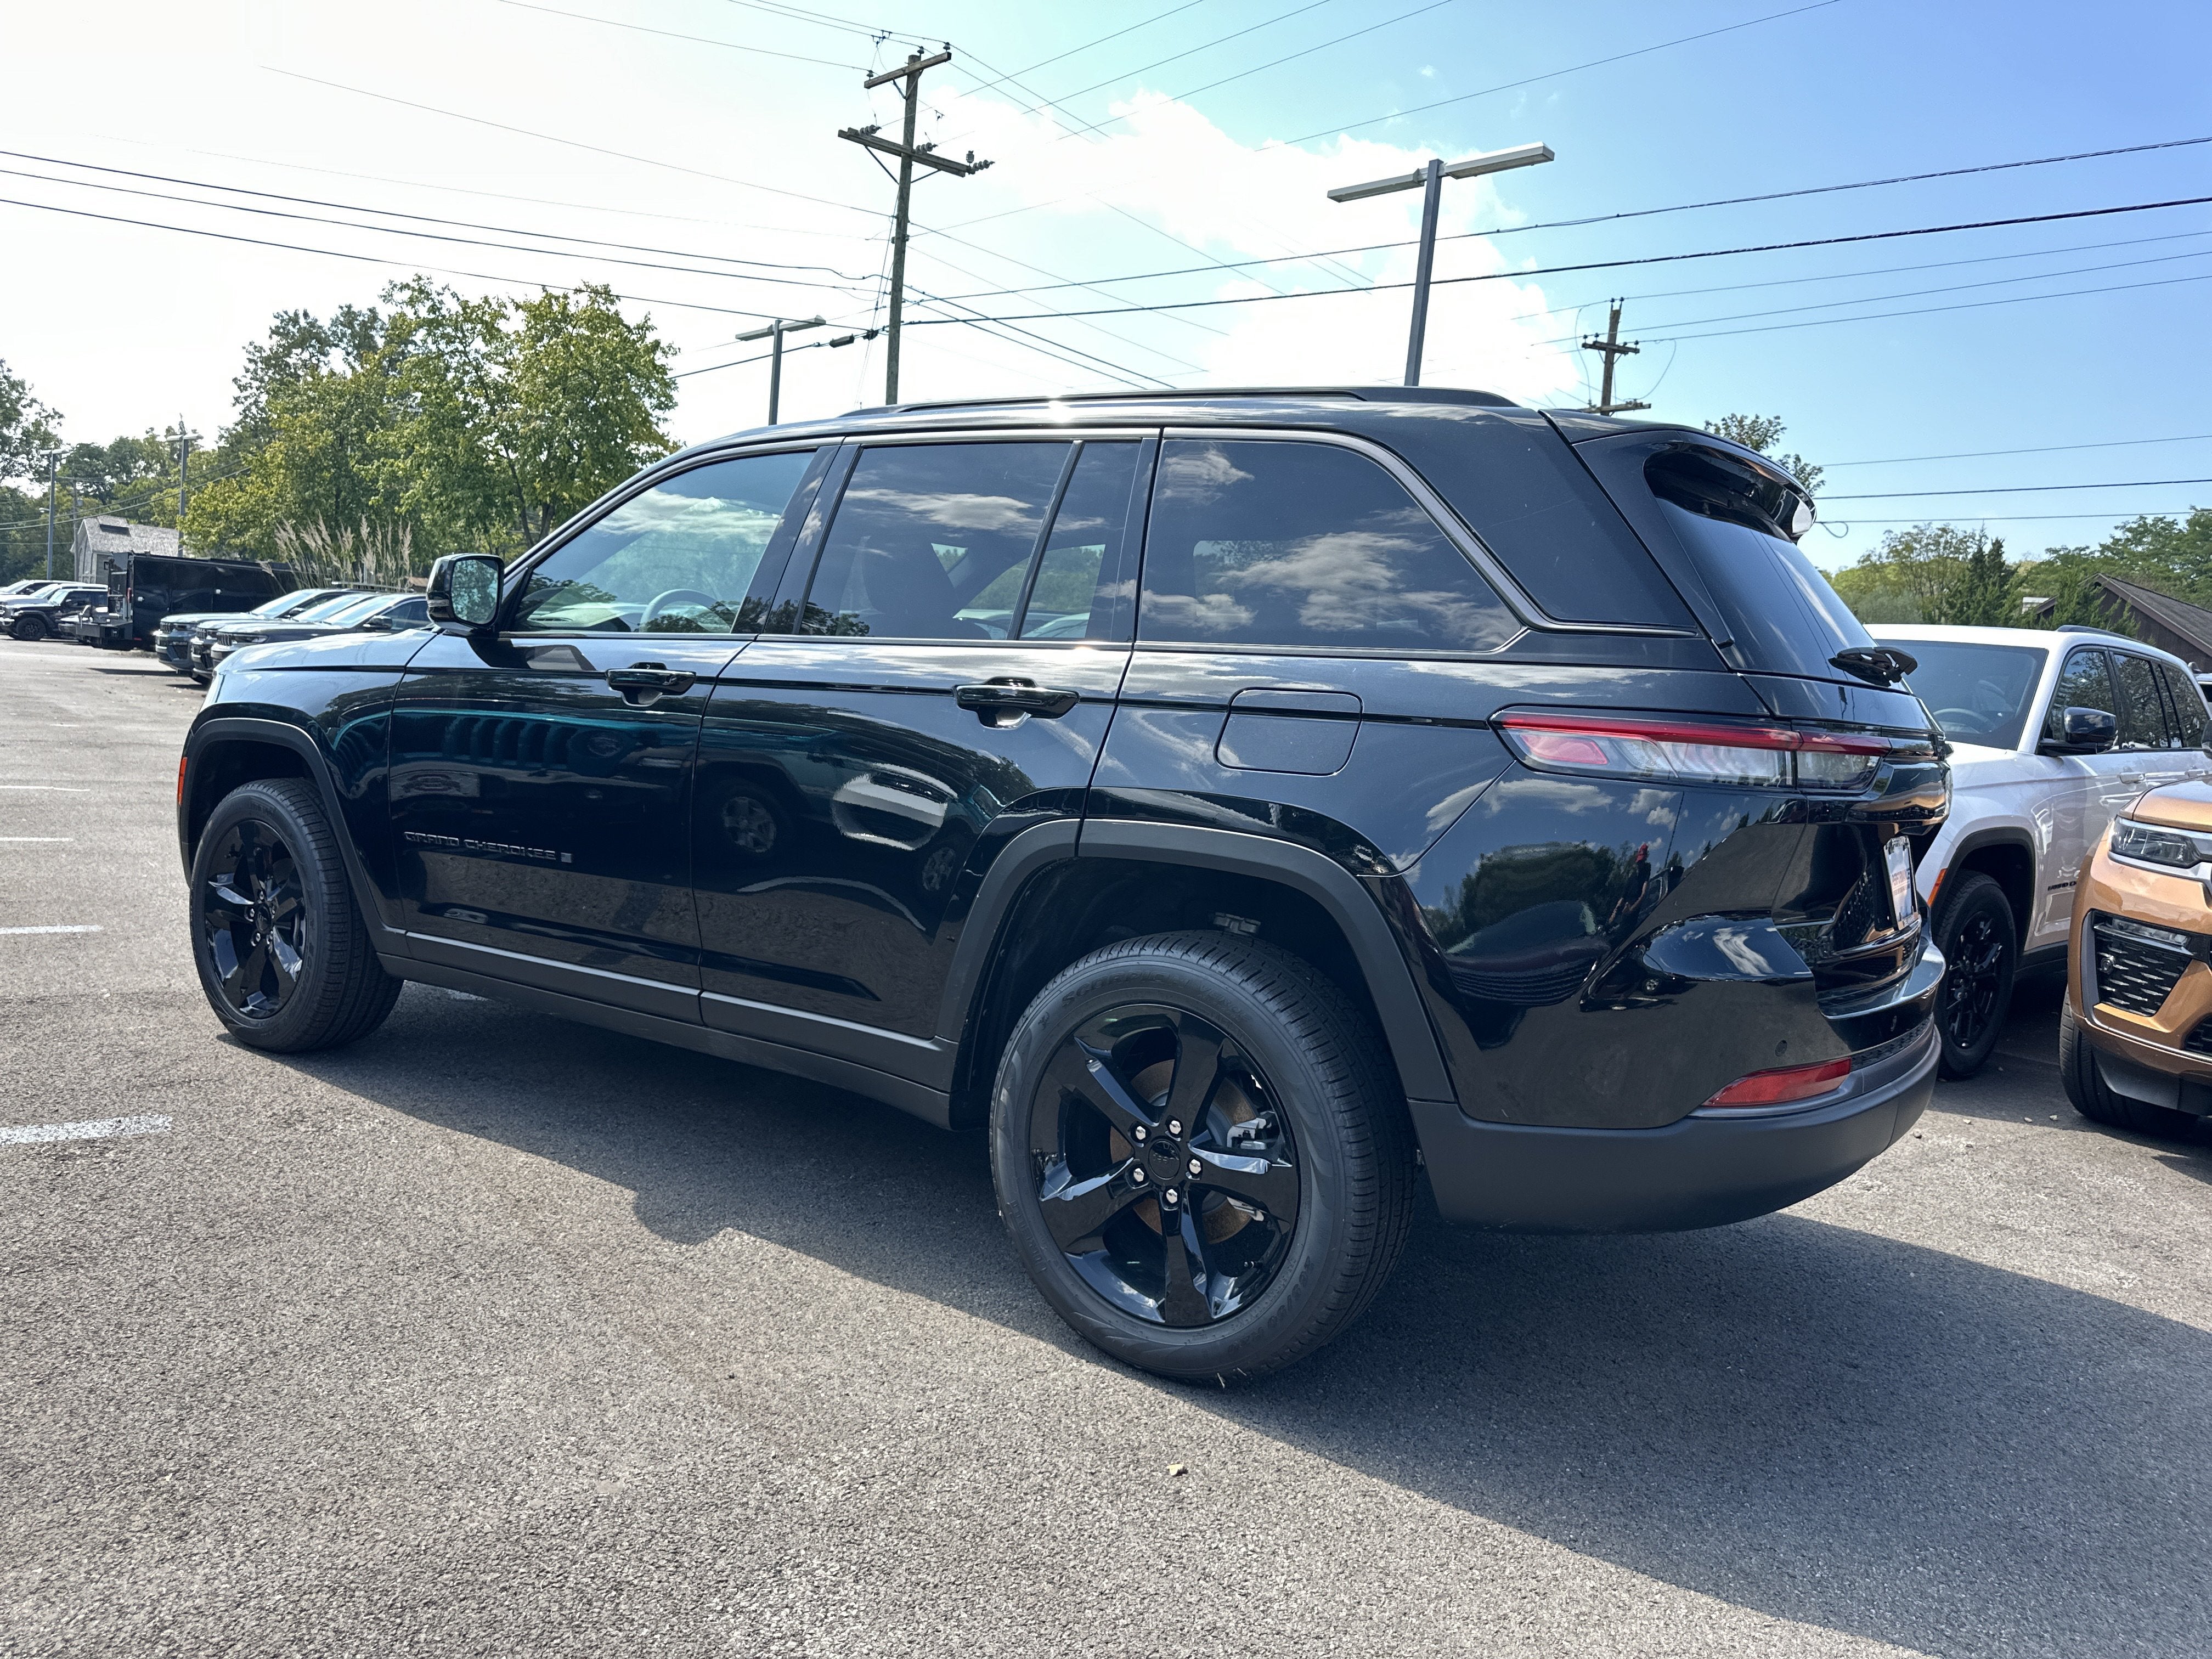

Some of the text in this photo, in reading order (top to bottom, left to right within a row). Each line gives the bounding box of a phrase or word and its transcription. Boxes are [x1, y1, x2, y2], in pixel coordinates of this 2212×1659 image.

[404, 831, 556, 861] GRAND CHEROKEE
[1062, 970, 1190, 1007] SCORPION
